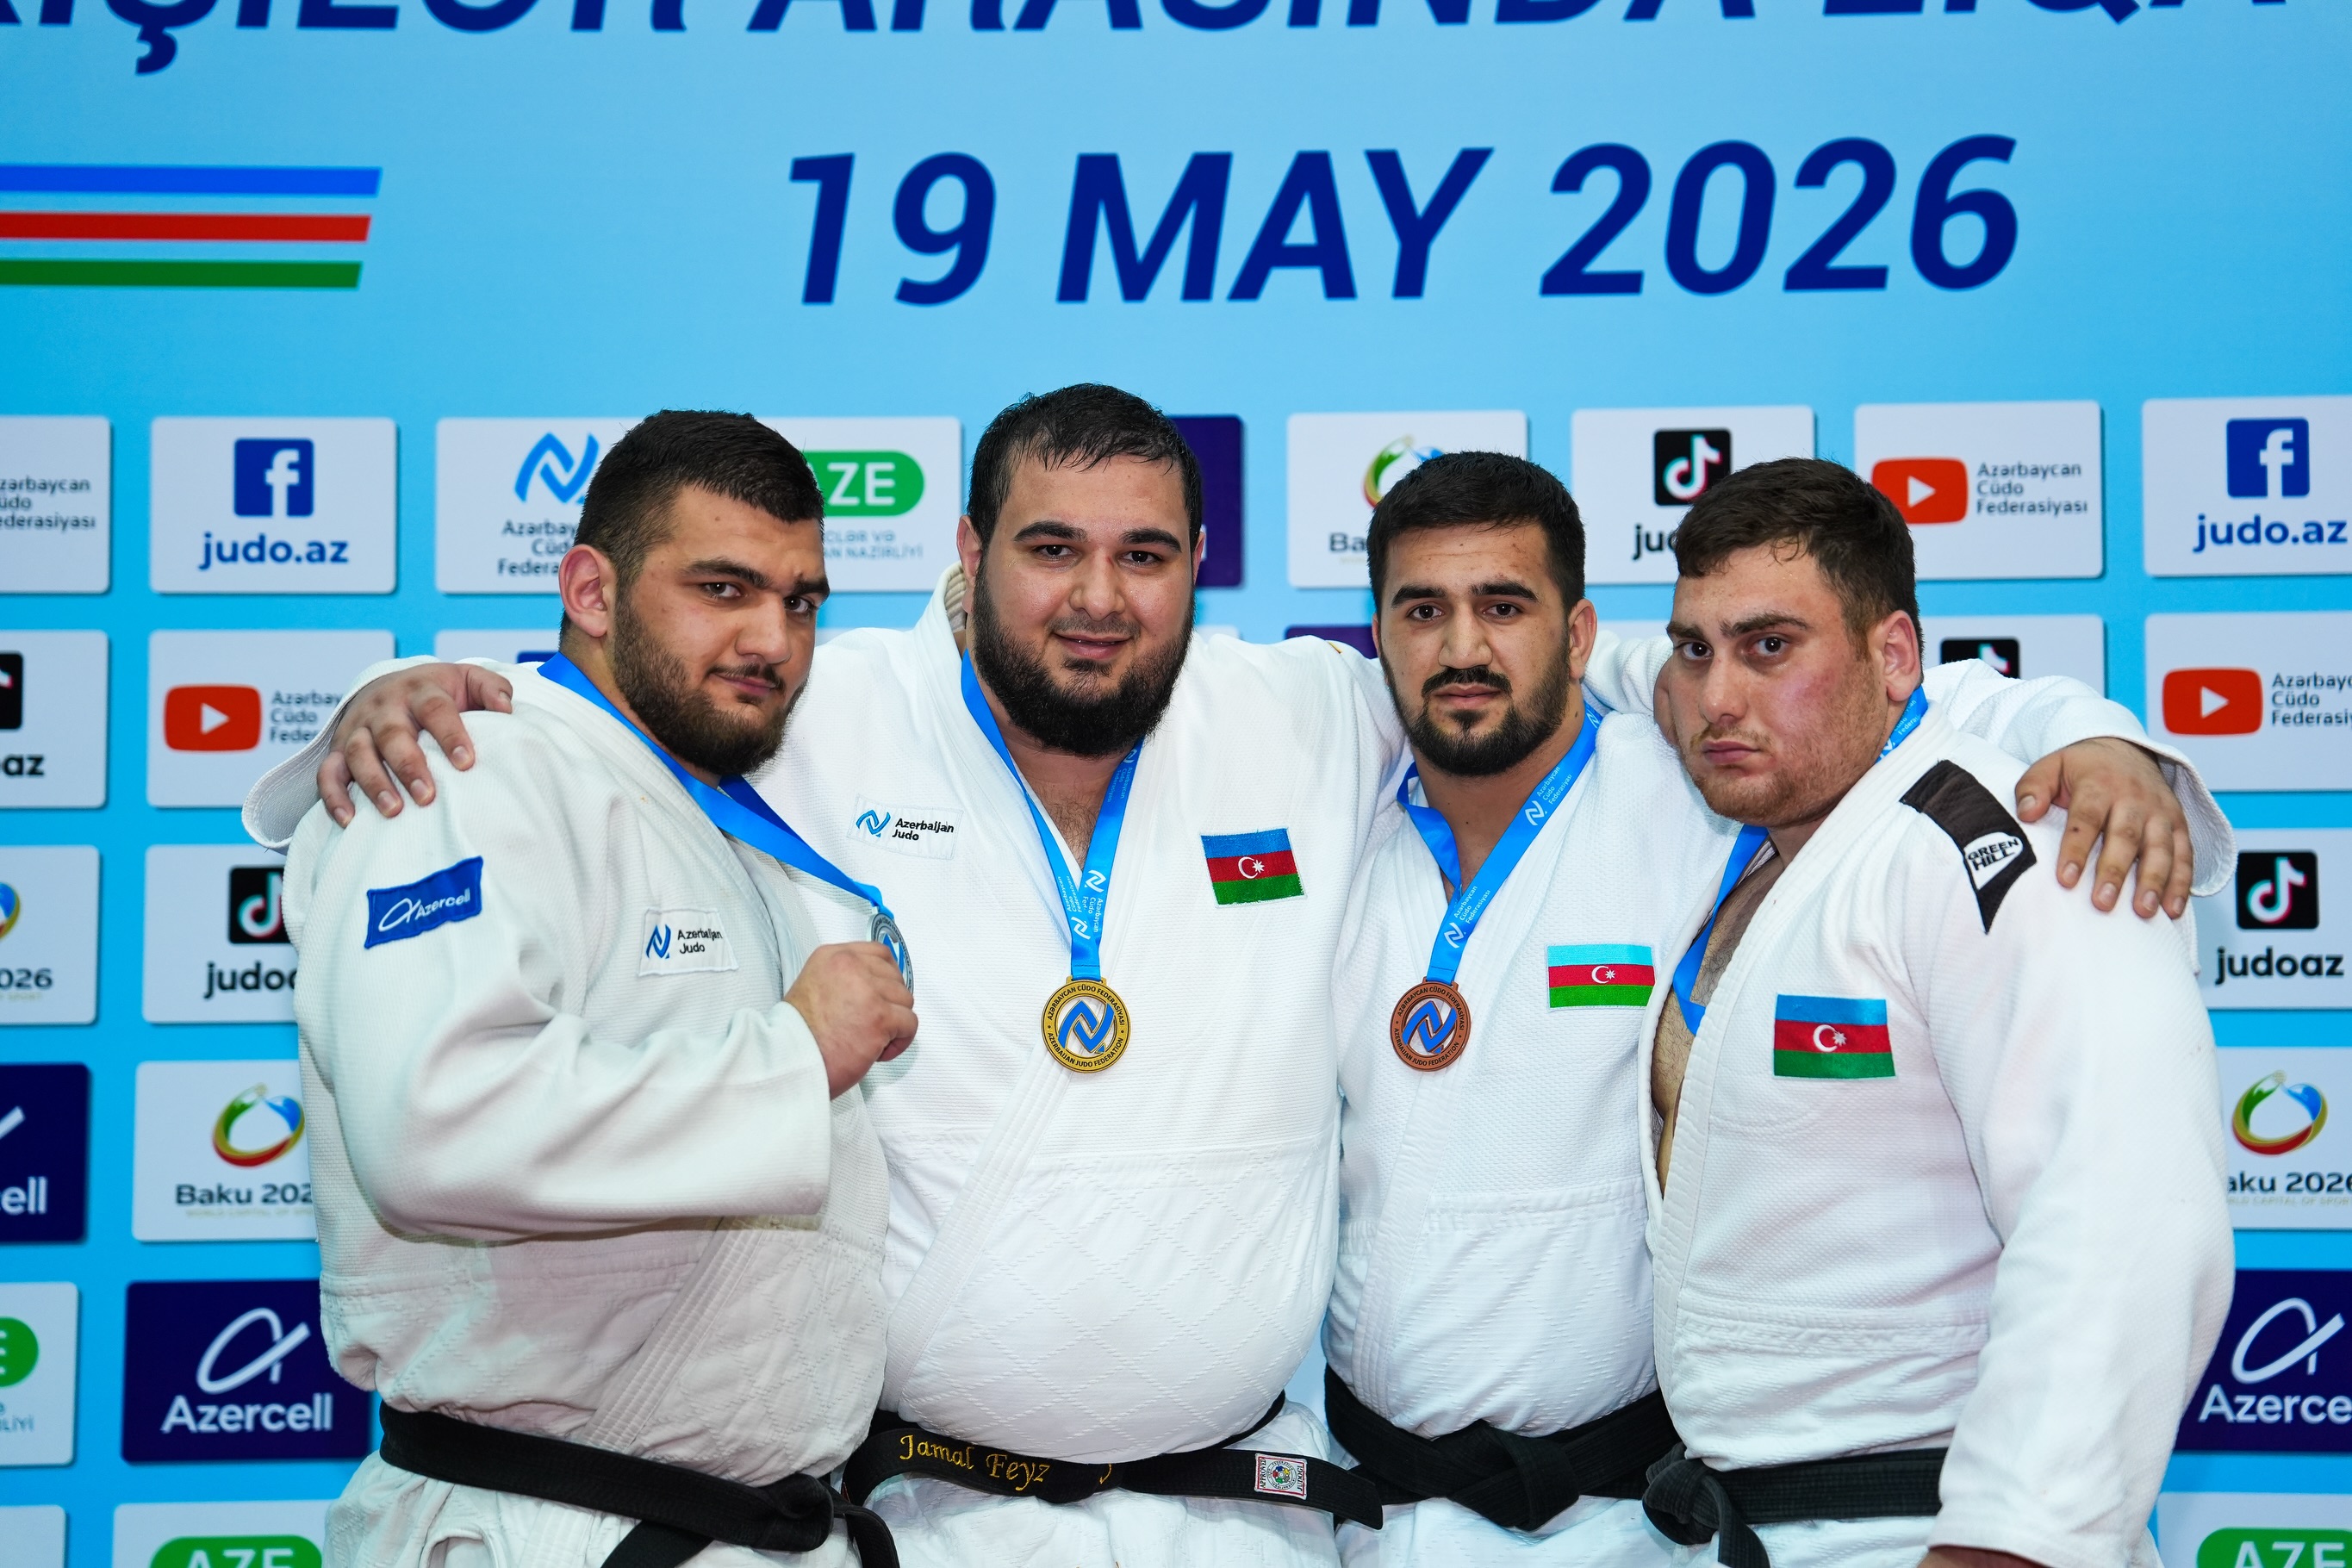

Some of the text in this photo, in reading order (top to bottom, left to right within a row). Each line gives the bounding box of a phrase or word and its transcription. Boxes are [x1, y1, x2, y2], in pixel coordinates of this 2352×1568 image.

[789, 134, 2018, 307] 19 MAY 2026
[1977, 462, 2081, 481] Azərbaycan
[0, 476, 91, 496] zərbaycan
[810, 461, 896, 507] ZE
[1976, 480, 2025, 496] Cüdo
[0, 494, 33, 511] üdo
[1976, 497, 2088, 518] Federasiyası
[0, 513, 96, 532] derasiyası
[2193, 513, 2349, 553] judo.az
[198, 531, 349, 570] judo.az
[531, 538, 569, 557] Cüd
[2272, 690, 2319, 708] Cüdo
[271, 707, 318, 724] Cüdo
[2272, 708, 2352, 727] Federasi
[892, 829, 919, 841] Judo
[895, 818, 955, 833] Azerbaijan
[1968, 838, 2019, 862] GREEN
[1972, 851, 2015, 872] HILL
[414, 887, 471, 920] Azercell
[677, 928, 723, 942] Azerbaijan
[679, 942, 706, 955] Judo
[2215, 946, 2344, 986] judoaz
[0, 968, 53, 991] 026
[203, 960, 297, 1000] judo
[1048, 986, 1076, 1021] AZƏRBAYCAN
[1397, 986, 1428, 1017] AZƏRBAYCAN
[1429, 986, 1447, 995] CÜDO
[1048, 1032, 1076, 1064] AZERBAIJAN
[1094, 1037, 1124, 1066] FEDERATION
[1394, 1028, 1460, 1067] AZERBAIJAN JUDO FEDERATION
[2228, 1171, 2276, 1192] aku
[175, 1183, 314, 1204] Baku 202
[160, 1393, 333, 1434] Azercell
[2199, 1384, 2352, 1424] Azerce
[899, 1434, 975, 1469] Jamal
